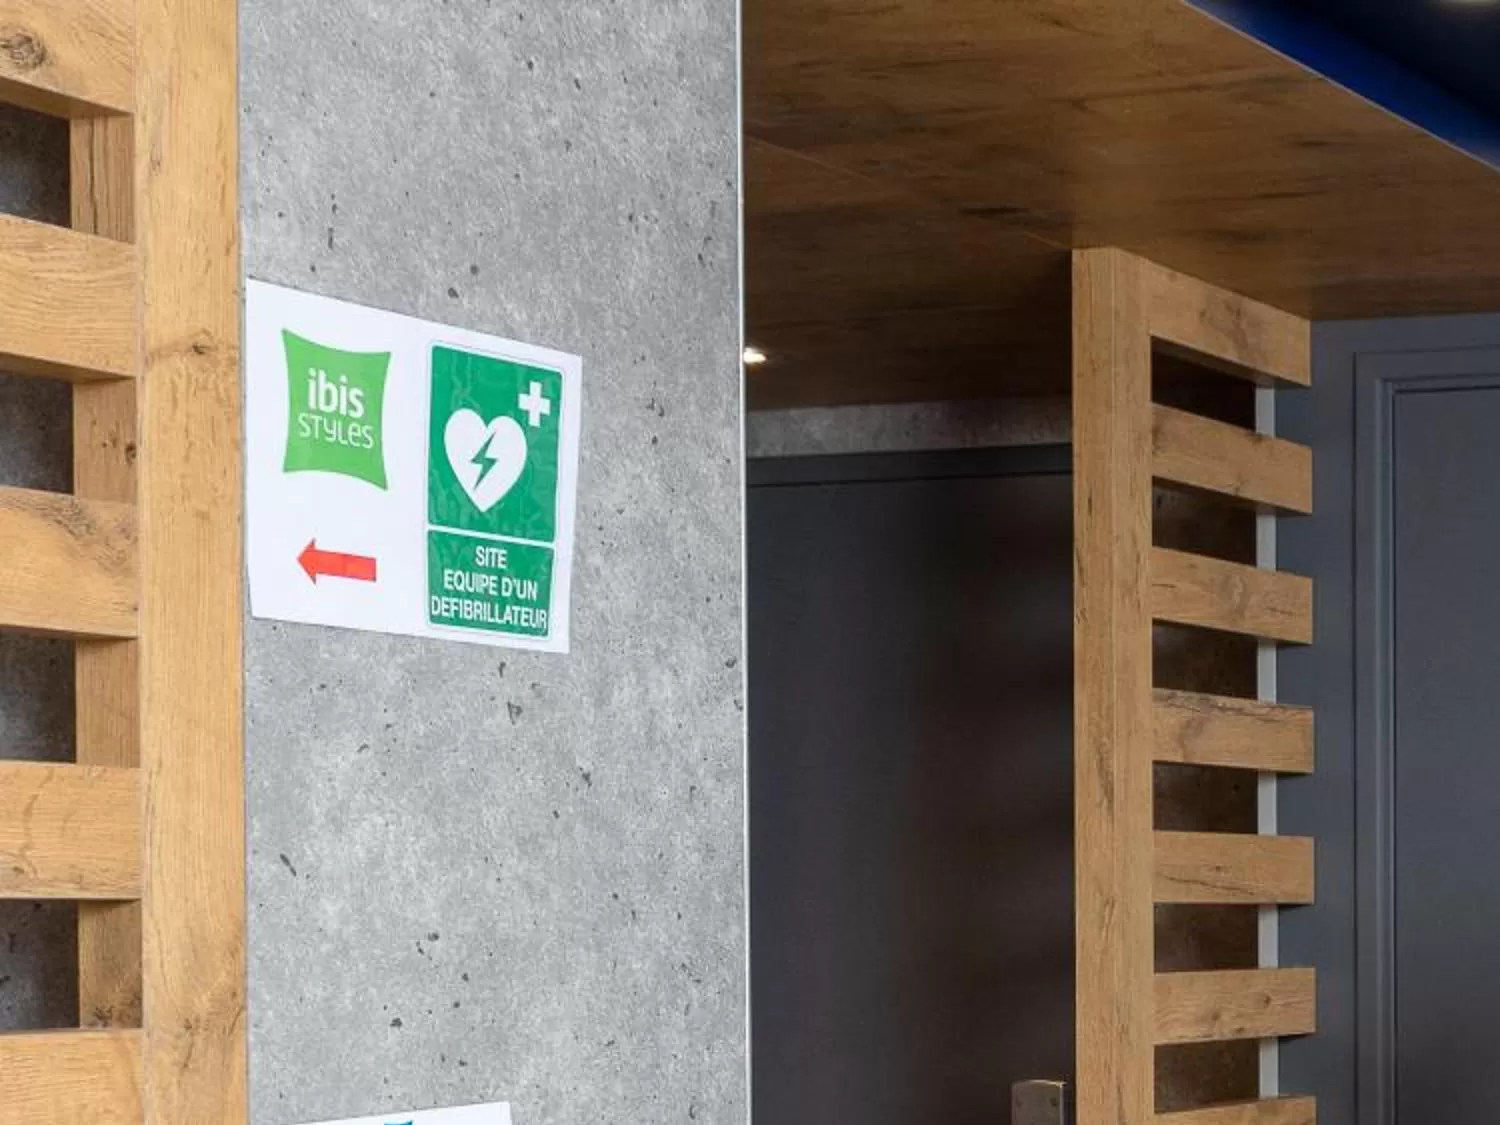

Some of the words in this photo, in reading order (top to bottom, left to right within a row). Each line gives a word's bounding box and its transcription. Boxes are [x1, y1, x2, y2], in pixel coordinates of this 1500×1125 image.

[308, 369, 365, 417] ibis
[475, 545, 508, 569] SITE
[443, 570, 498, 596] EQUIPE
[501, 577, 538, 601] D'UN
[431, 596, 549, 630] DEFIBRILLATEUR
